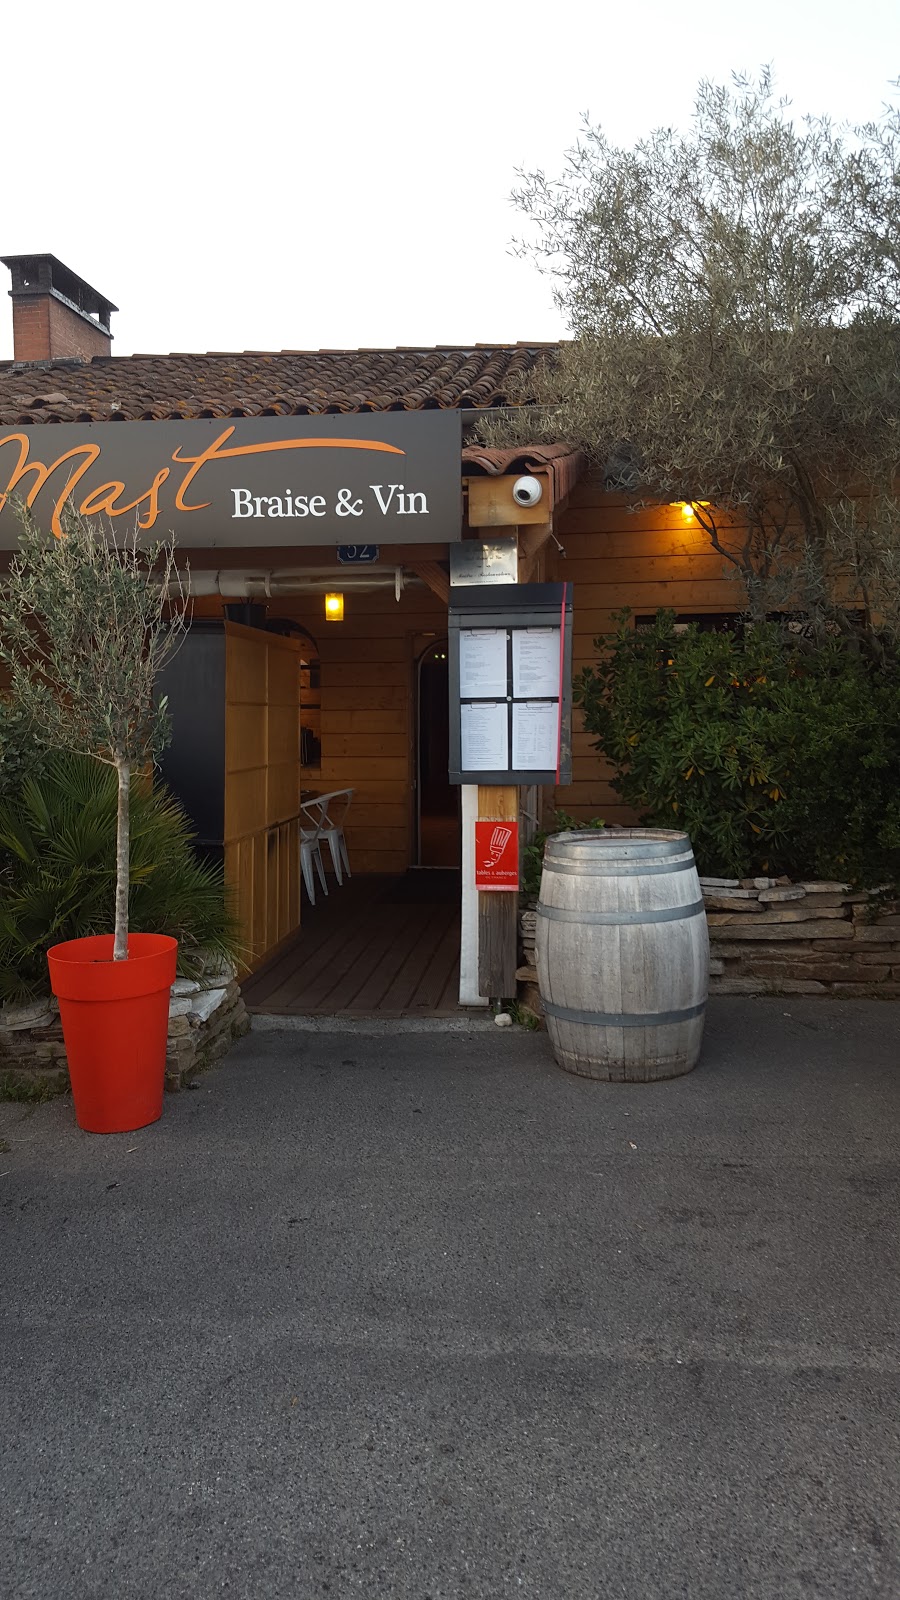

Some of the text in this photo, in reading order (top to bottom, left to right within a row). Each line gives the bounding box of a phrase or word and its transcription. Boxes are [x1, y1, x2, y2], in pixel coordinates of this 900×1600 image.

[0, 425, 406, 540] Mast
[230, 484, 430, 518] Braise & Vin
